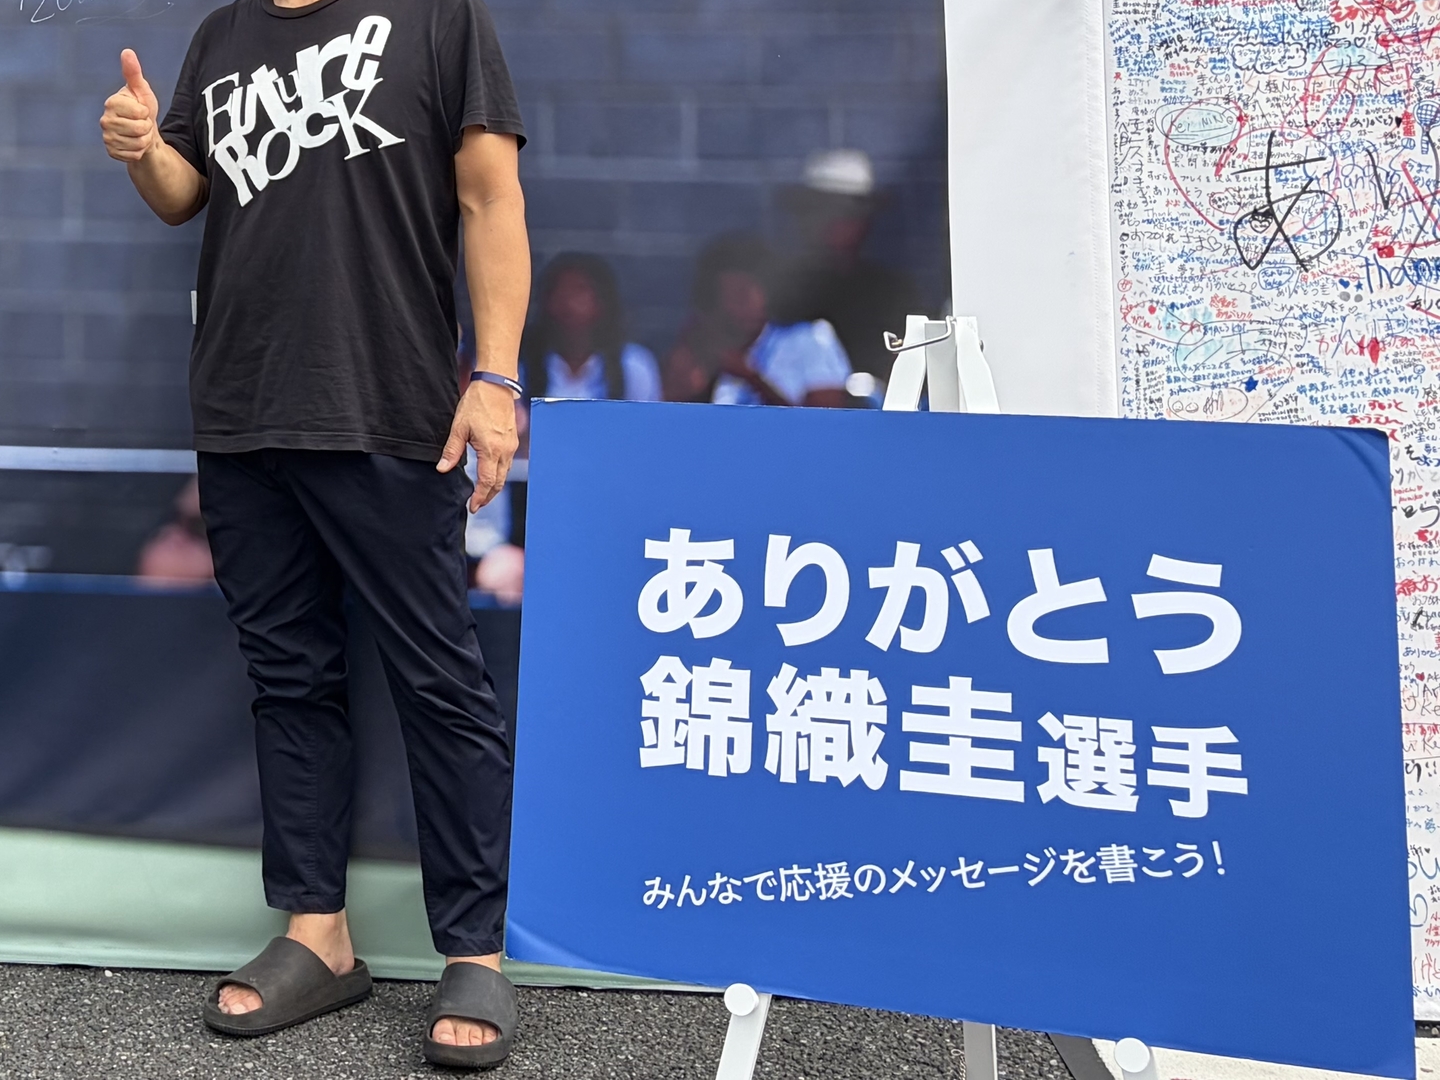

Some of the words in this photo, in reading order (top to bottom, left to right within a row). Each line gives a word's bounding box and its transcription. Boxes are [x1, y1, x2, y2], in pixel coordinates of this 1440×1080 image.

[637, 527, 1242, 675] ありがとう
[639, 655, 1248, 818] 錦織圭選手
[642, 841, 1226, 910] みんなで応援のメッセージを書こう!
